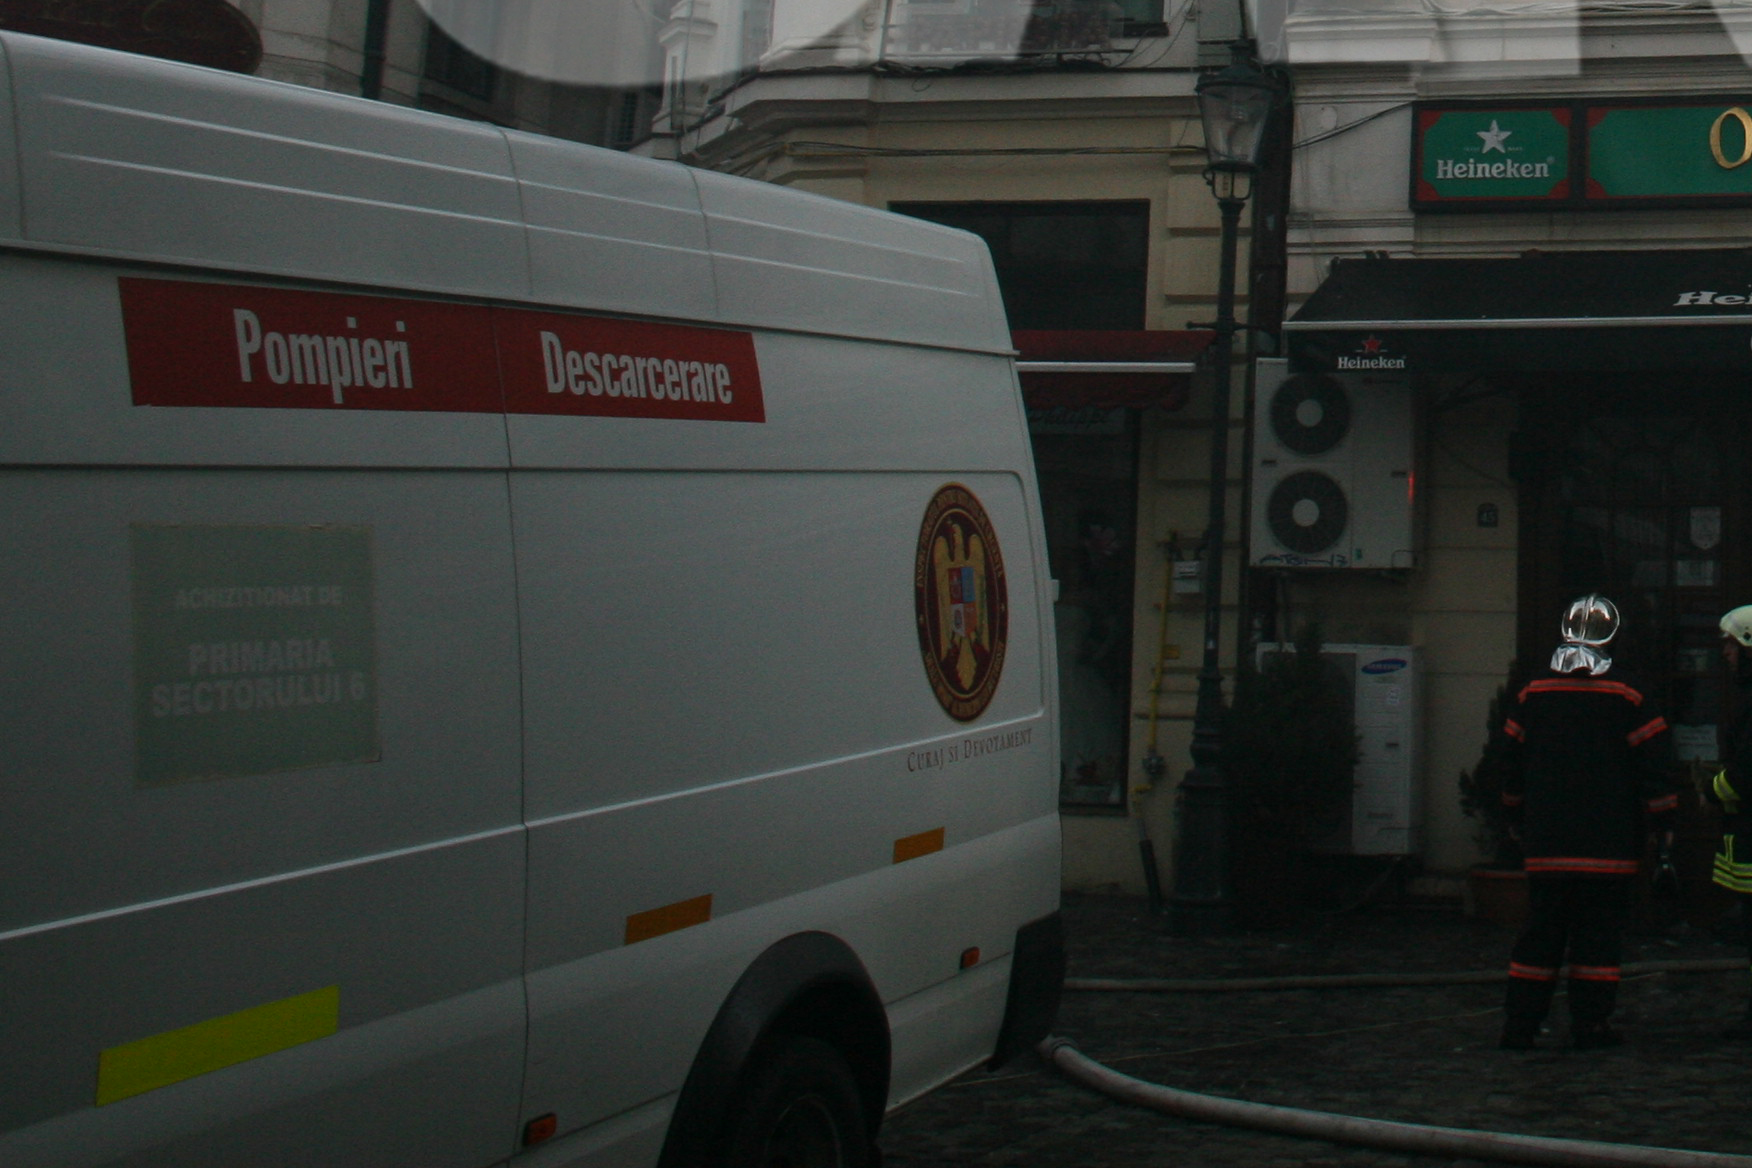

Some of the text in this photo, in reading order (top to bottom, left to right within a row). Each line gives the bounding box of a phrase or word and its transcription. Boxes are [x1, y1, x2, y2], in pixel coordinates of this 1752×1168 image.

[1436, 158, 1550, 179] Heineken
[233, 308, 733, 405] Pompieri Descarcerare
[1337, 356, 1406, 369] Heineken
[317, 585, 344, 607] DE
[187, 638, 336, 677] PRIMARIA
[151, 670, 366, 719] SECTORULUI 6
